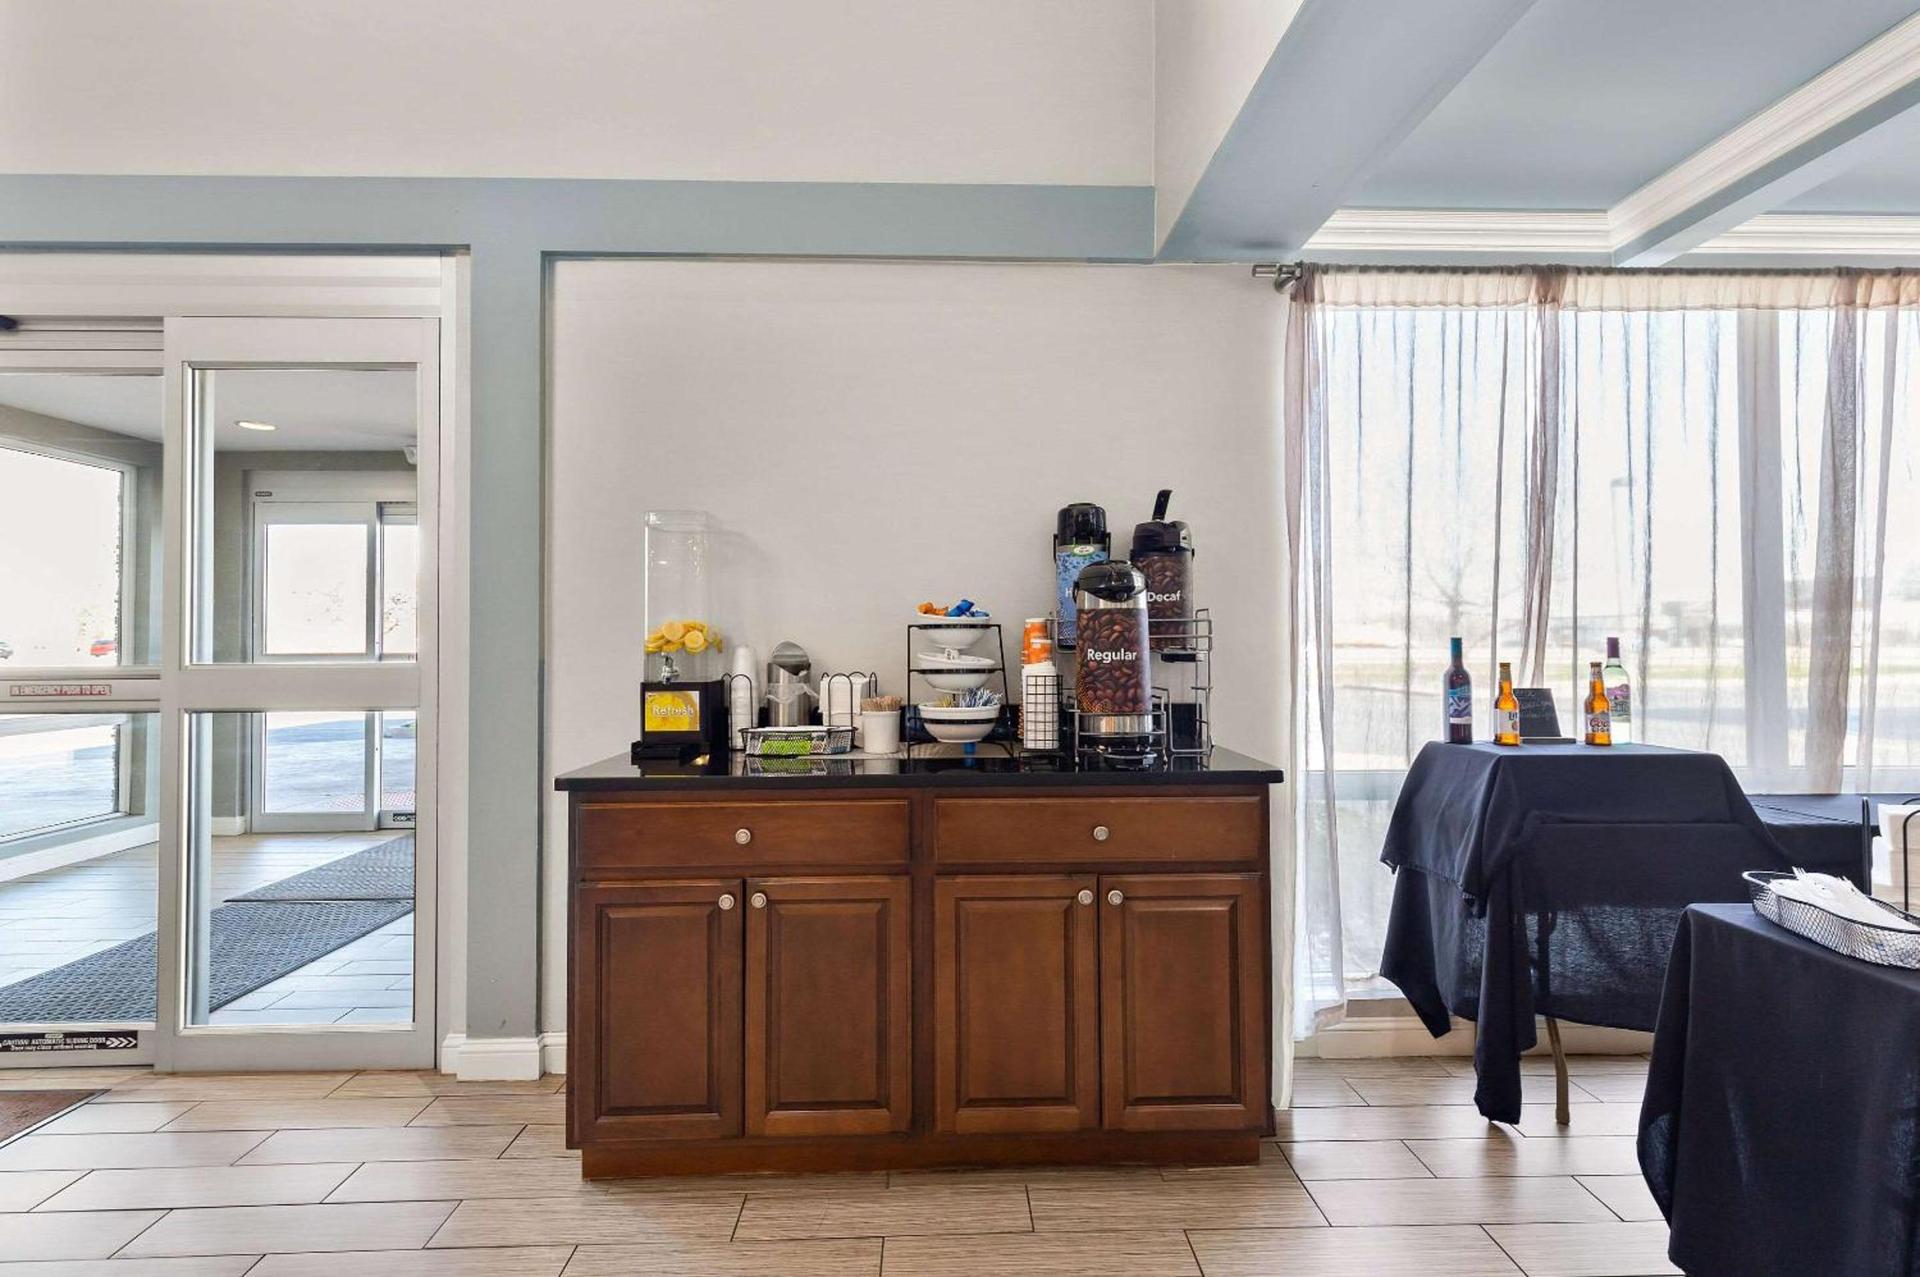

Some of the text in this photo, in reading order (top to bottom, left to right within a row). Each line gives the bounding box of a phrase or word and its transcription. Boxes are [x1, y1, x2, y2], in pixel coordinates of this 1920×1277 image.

[1147, 590, 1181, 602] Decaf
[1087, 648, 1137, 663] Regular
[652, 704, 694, 717] Refresh
